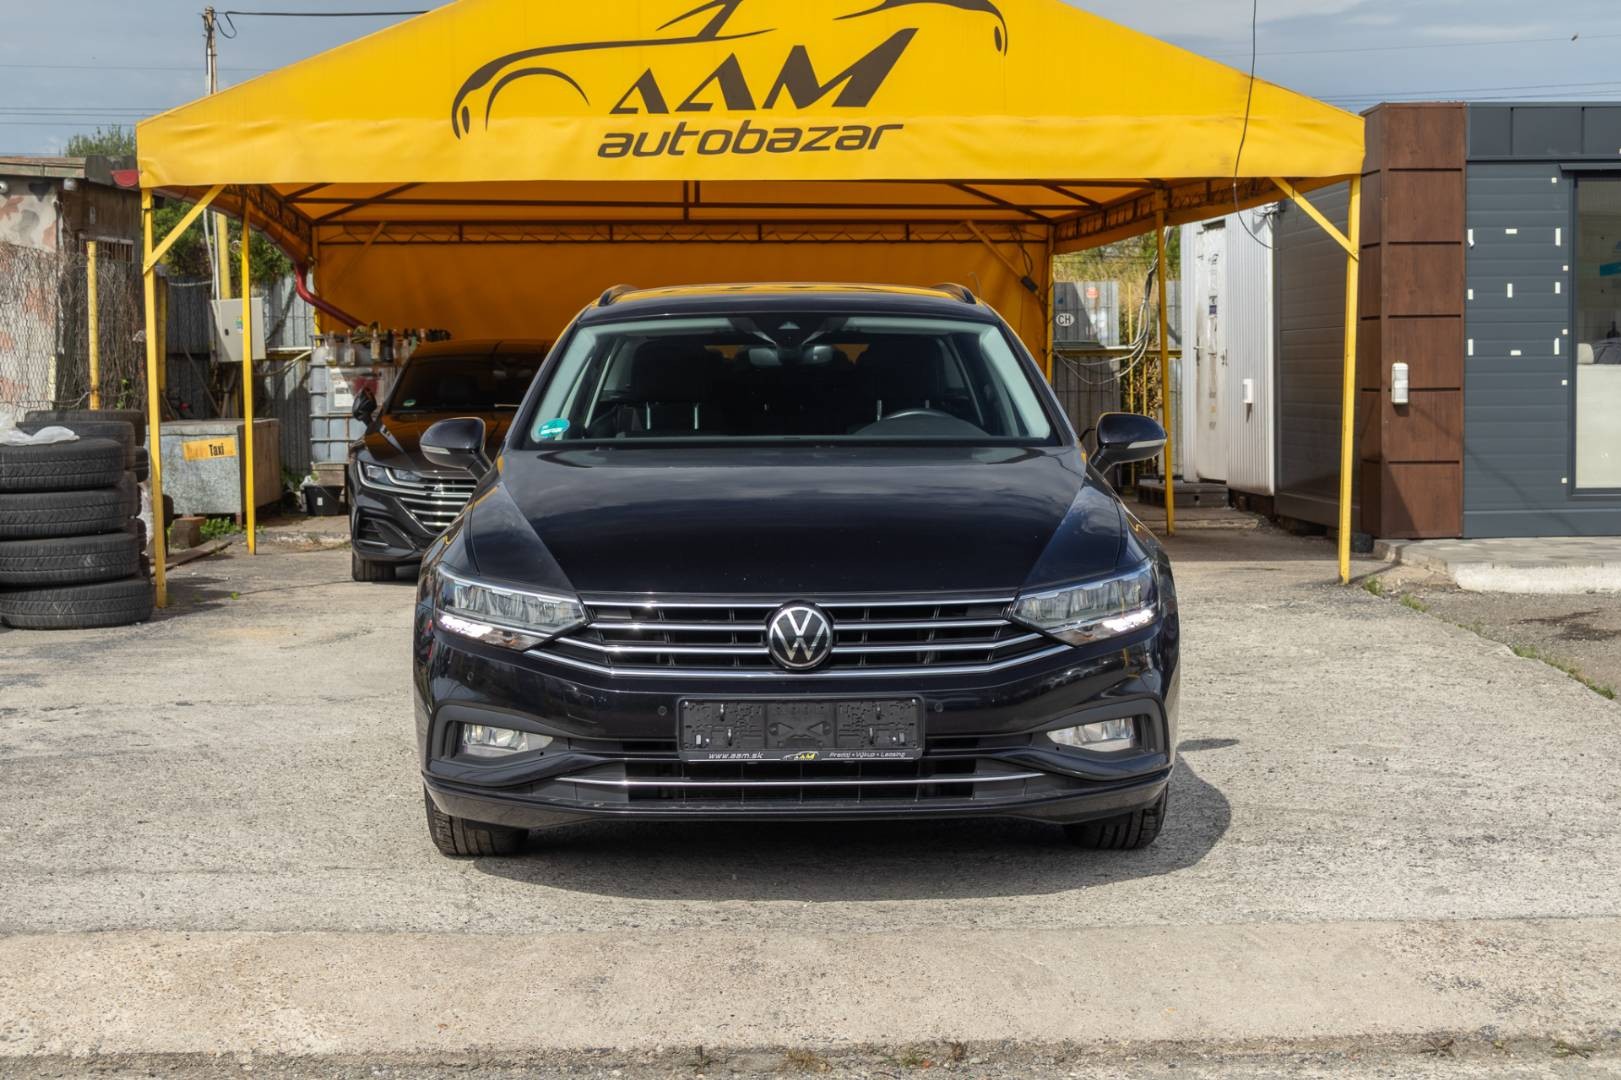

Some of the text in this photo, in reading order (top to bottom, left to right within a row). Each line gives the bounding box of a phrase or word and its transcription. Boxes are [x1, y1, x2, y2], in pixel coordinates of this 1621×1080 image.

[609, 28, 920, 115] AAM
[597, 119, 904, 159] autobazar
[1058, 315, 1071, 325] CH
[208, 442, 225, 457] Taxi
